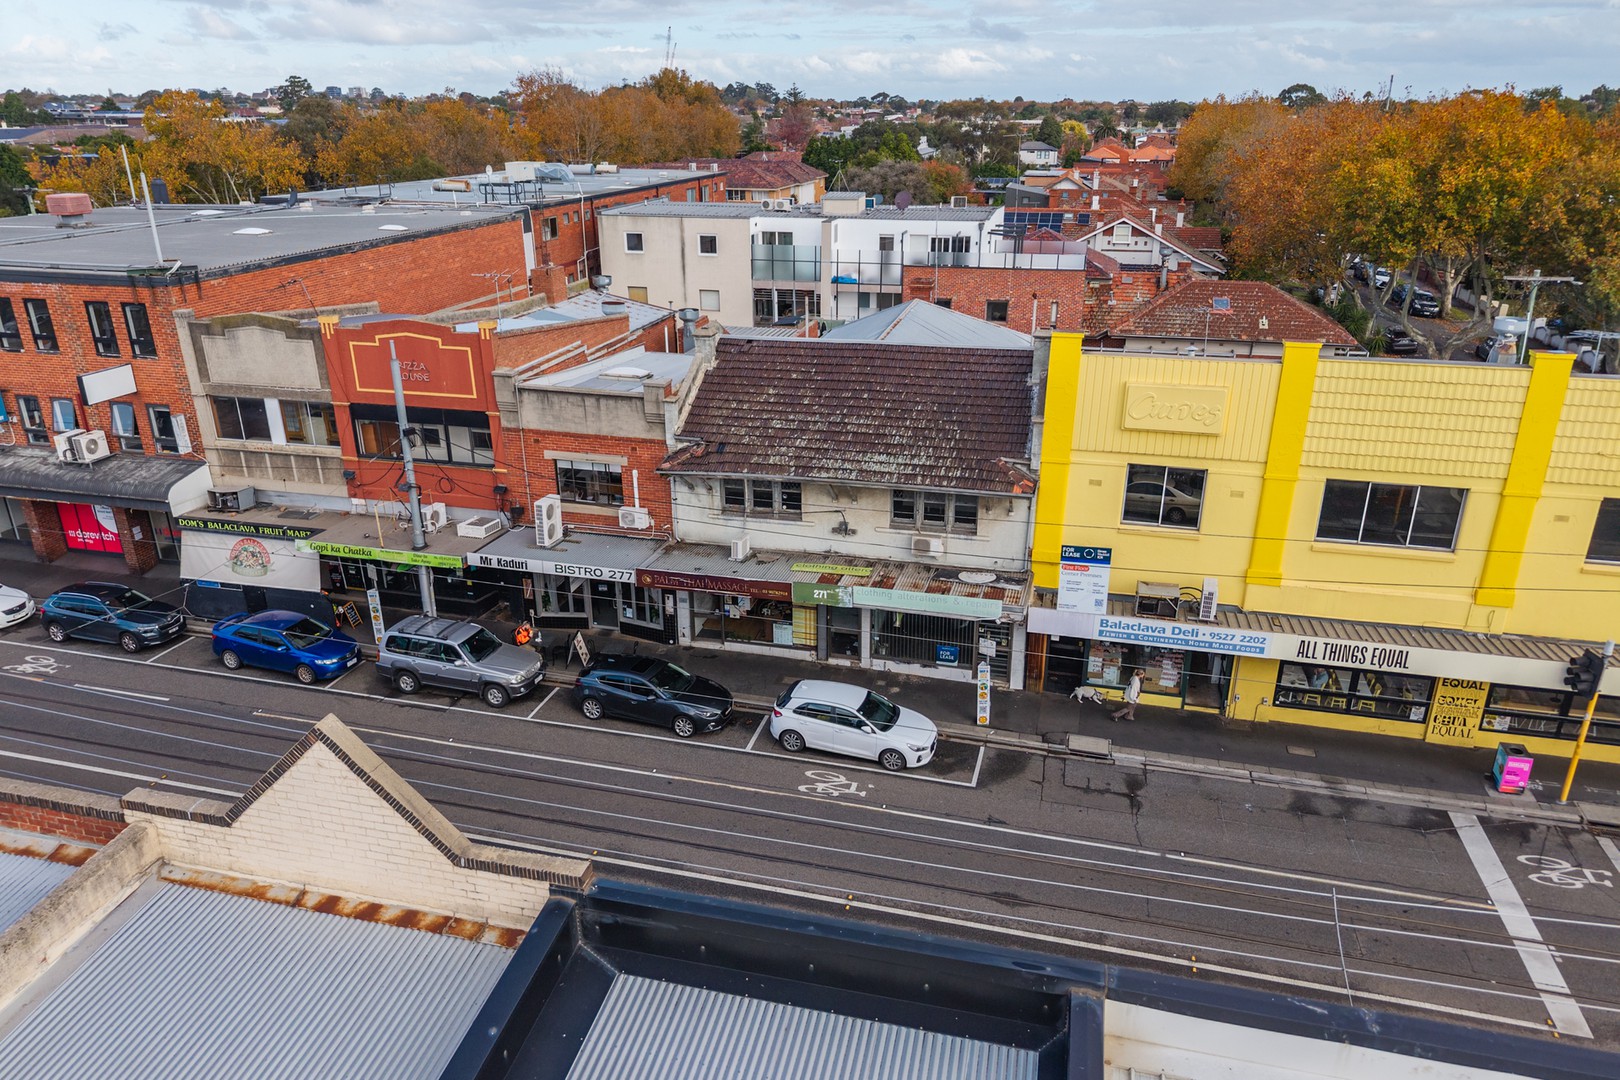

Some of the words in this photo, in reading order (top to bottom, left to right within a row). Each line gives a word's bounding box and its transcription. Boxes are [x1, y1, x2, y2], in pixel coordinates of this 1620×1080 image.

[402, 372, 430, 382] OUSE
[179, 519, 204, 528] DOM'S
[207, 521, 256, 534] BALACLAVA
[259, 527, 283, 536] FRUIT
[287, 530, 311, 538] MART
[309, 542, 329, 553] Gopi
[330, 545, 341, 553] ka
[342, 546, 373, 557] Chatka
[479, 556, 493, 566] Mr
[497, 558, 528, 570] Kaduri
[554, 564, 603, 578] BISTRO
[608, 570, 633, 581] 277
[707, 580, 750, 592] MASSAGE
[813, 589, 828, 599] 271
[857, 588, 892, 600] clothing
[897, 593, 948, 604] alterations
[1100, 618, 1166, 635] Balaclava
[1171, 626, 1199, 638] Deli
[1209, 632, 1236, 641] 9527
[1239, 635, 1267, 645] 2202
[1188, 640, 1209, 648] HOME
[1235, 644, 1260, 652] FOODS
[1297, 640, 1317, 659] ALL
[1322, 642, 1368, 665] THINGS
[1370, 648, 1409, 669] EQUAL
[1442, 678, 1485, 691] EQUAL
[1432, 725, 1473, 739] EQUAL
